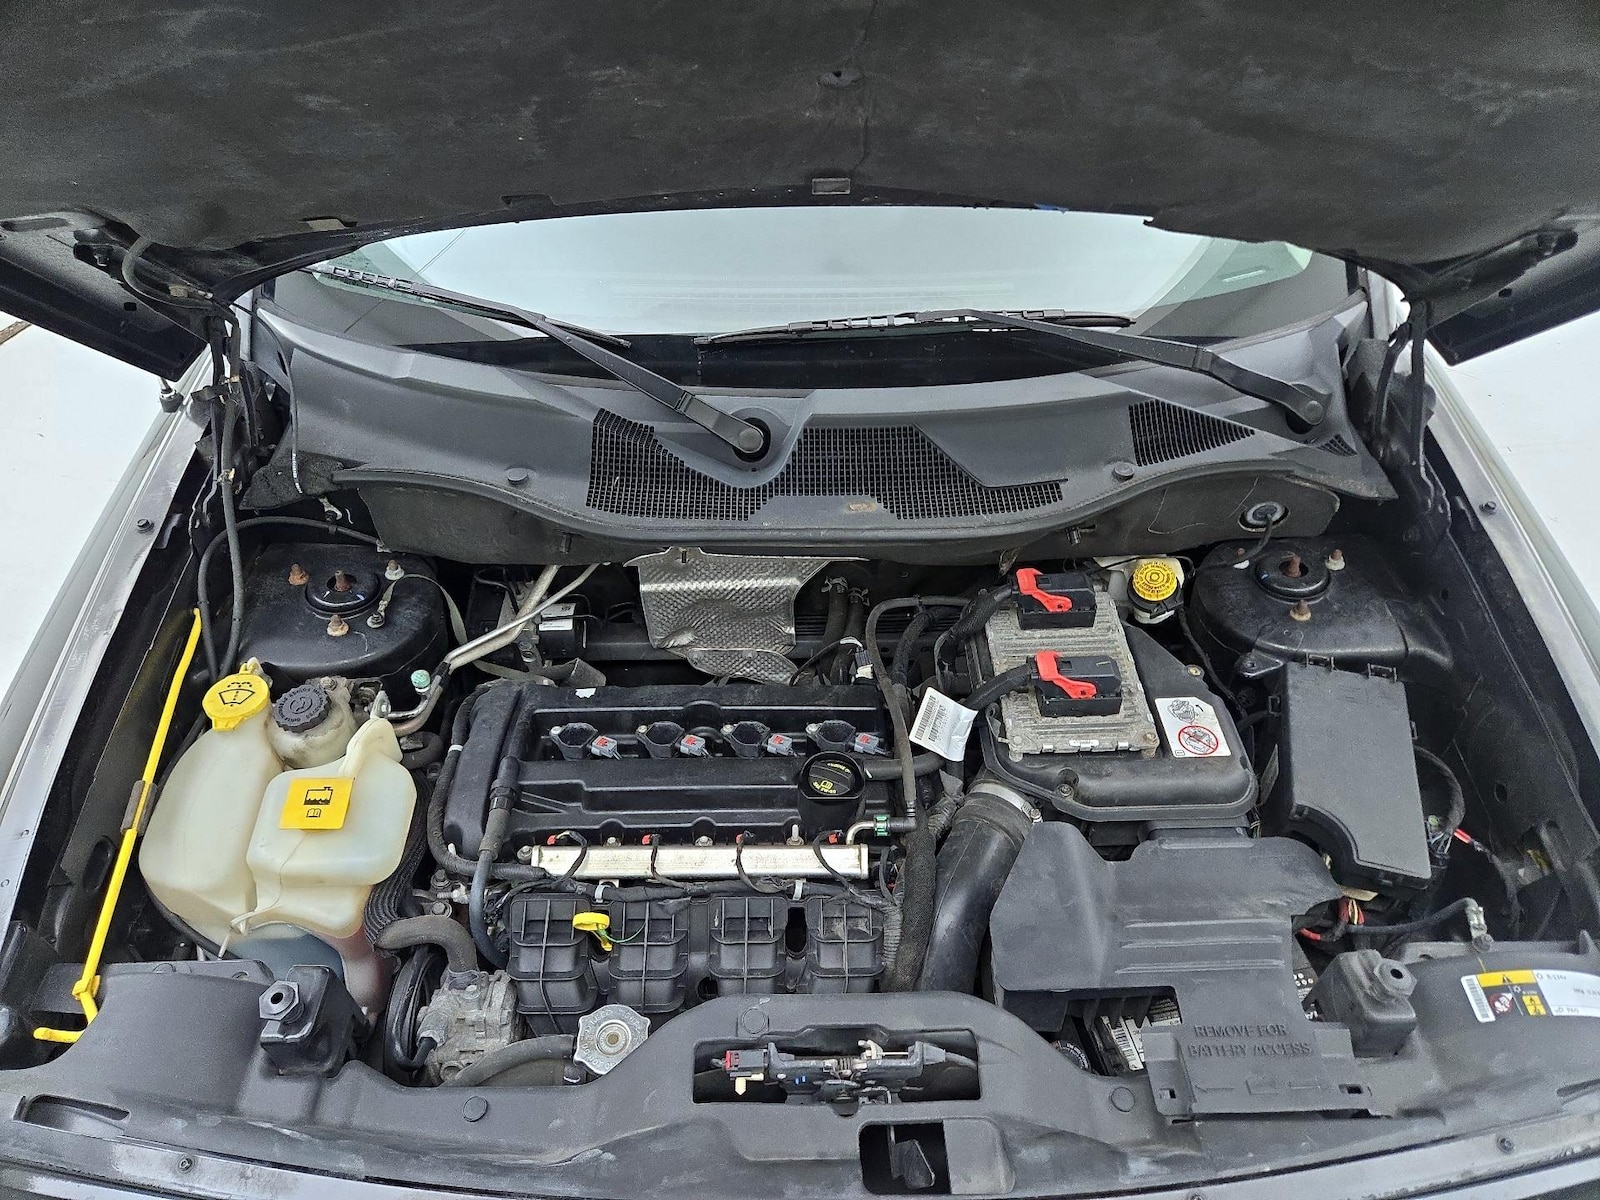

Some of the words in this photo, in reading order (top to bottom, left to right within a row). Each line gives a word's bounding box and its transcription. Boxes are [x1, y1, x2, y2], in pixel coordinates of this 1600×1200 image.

[1194, 1025, 1253, 1037] REMOVE
[1257, 1023, 1288, 1036] FOR
[1188, 1043, 1247, 1056] BATTERY
[1254, 1042, 1311, 1055] ACCESS
